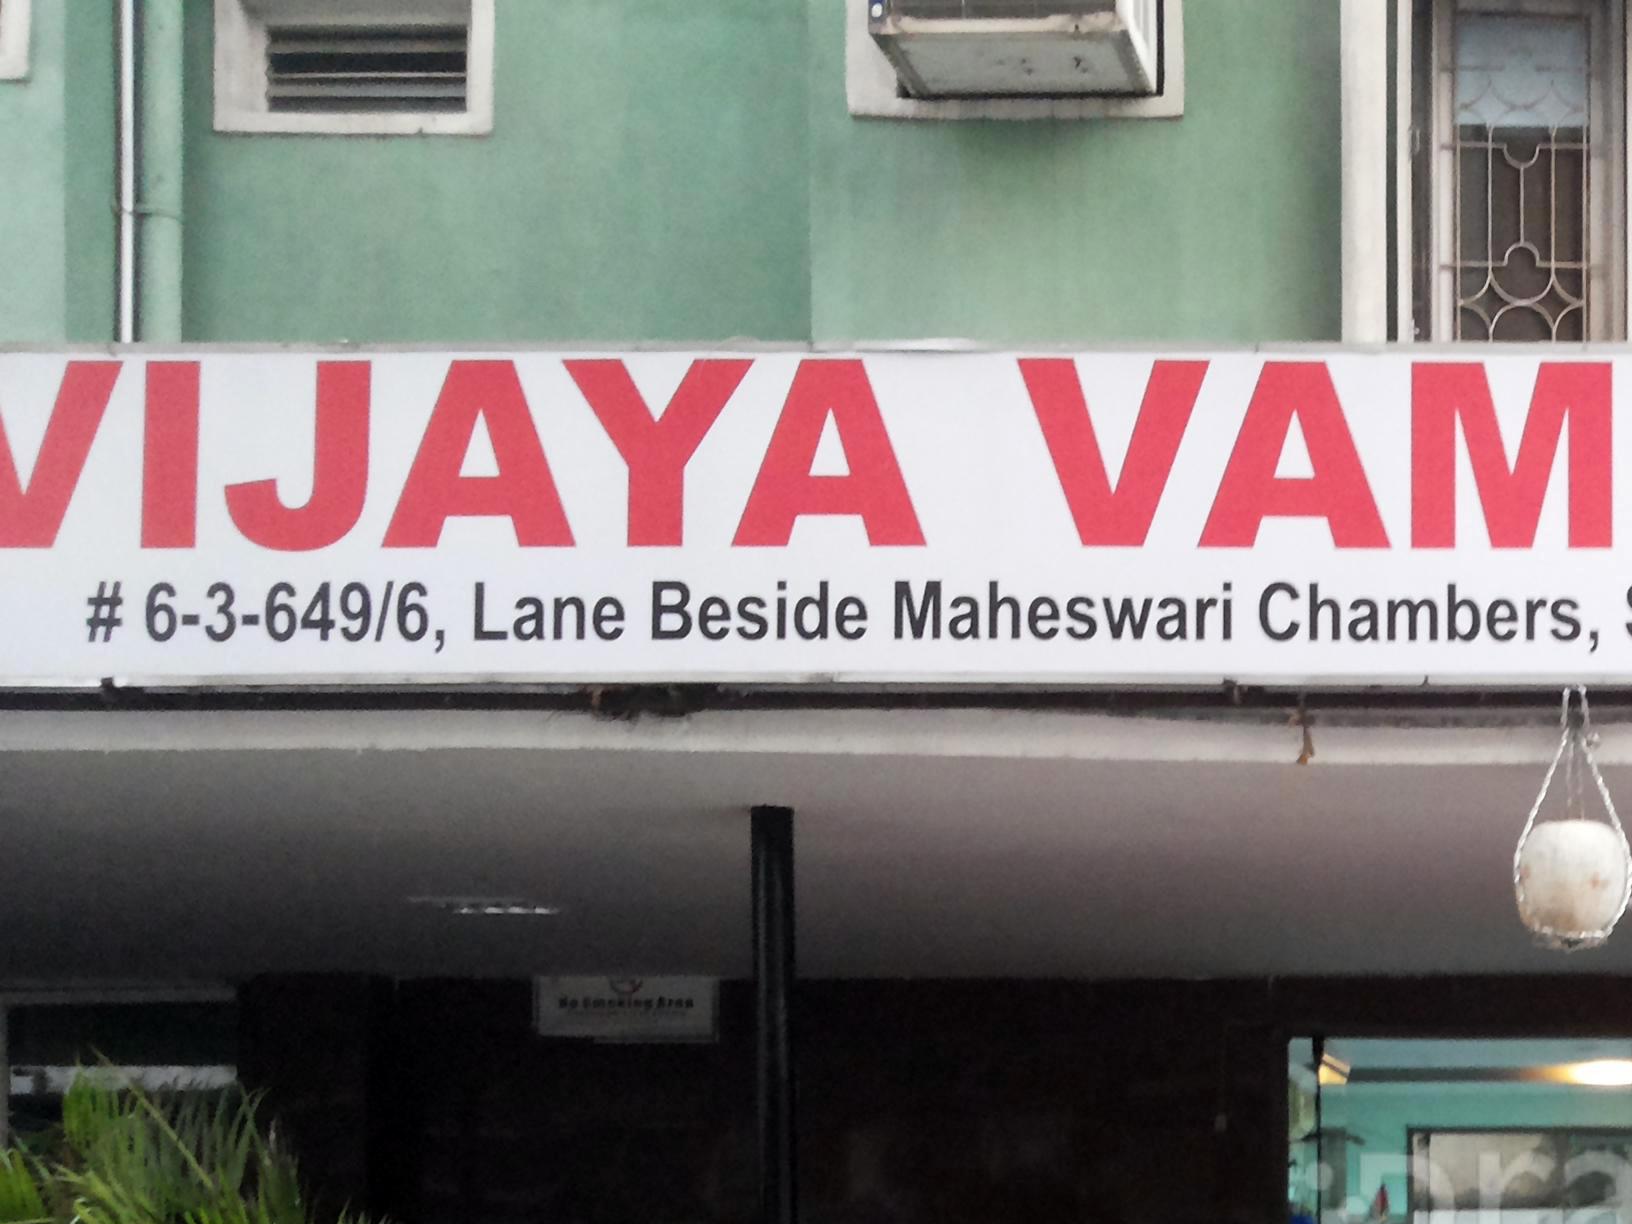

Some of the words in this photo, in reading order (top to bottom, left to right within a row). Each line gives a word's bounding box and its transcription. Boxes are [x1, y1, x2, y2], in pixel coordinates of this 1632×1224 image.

[0, 357, 928, 554] VIJAYA
[86, 581, 123, 643] #
[145, 581, 445, 653] 6-3-649/6,
[473, 581, 625, 641] Lane
[651, 580, 868, 641] Beside
[894, 580, 1232, 641] Maheswari
[1258, 581, 1599, 653] Chambers,
